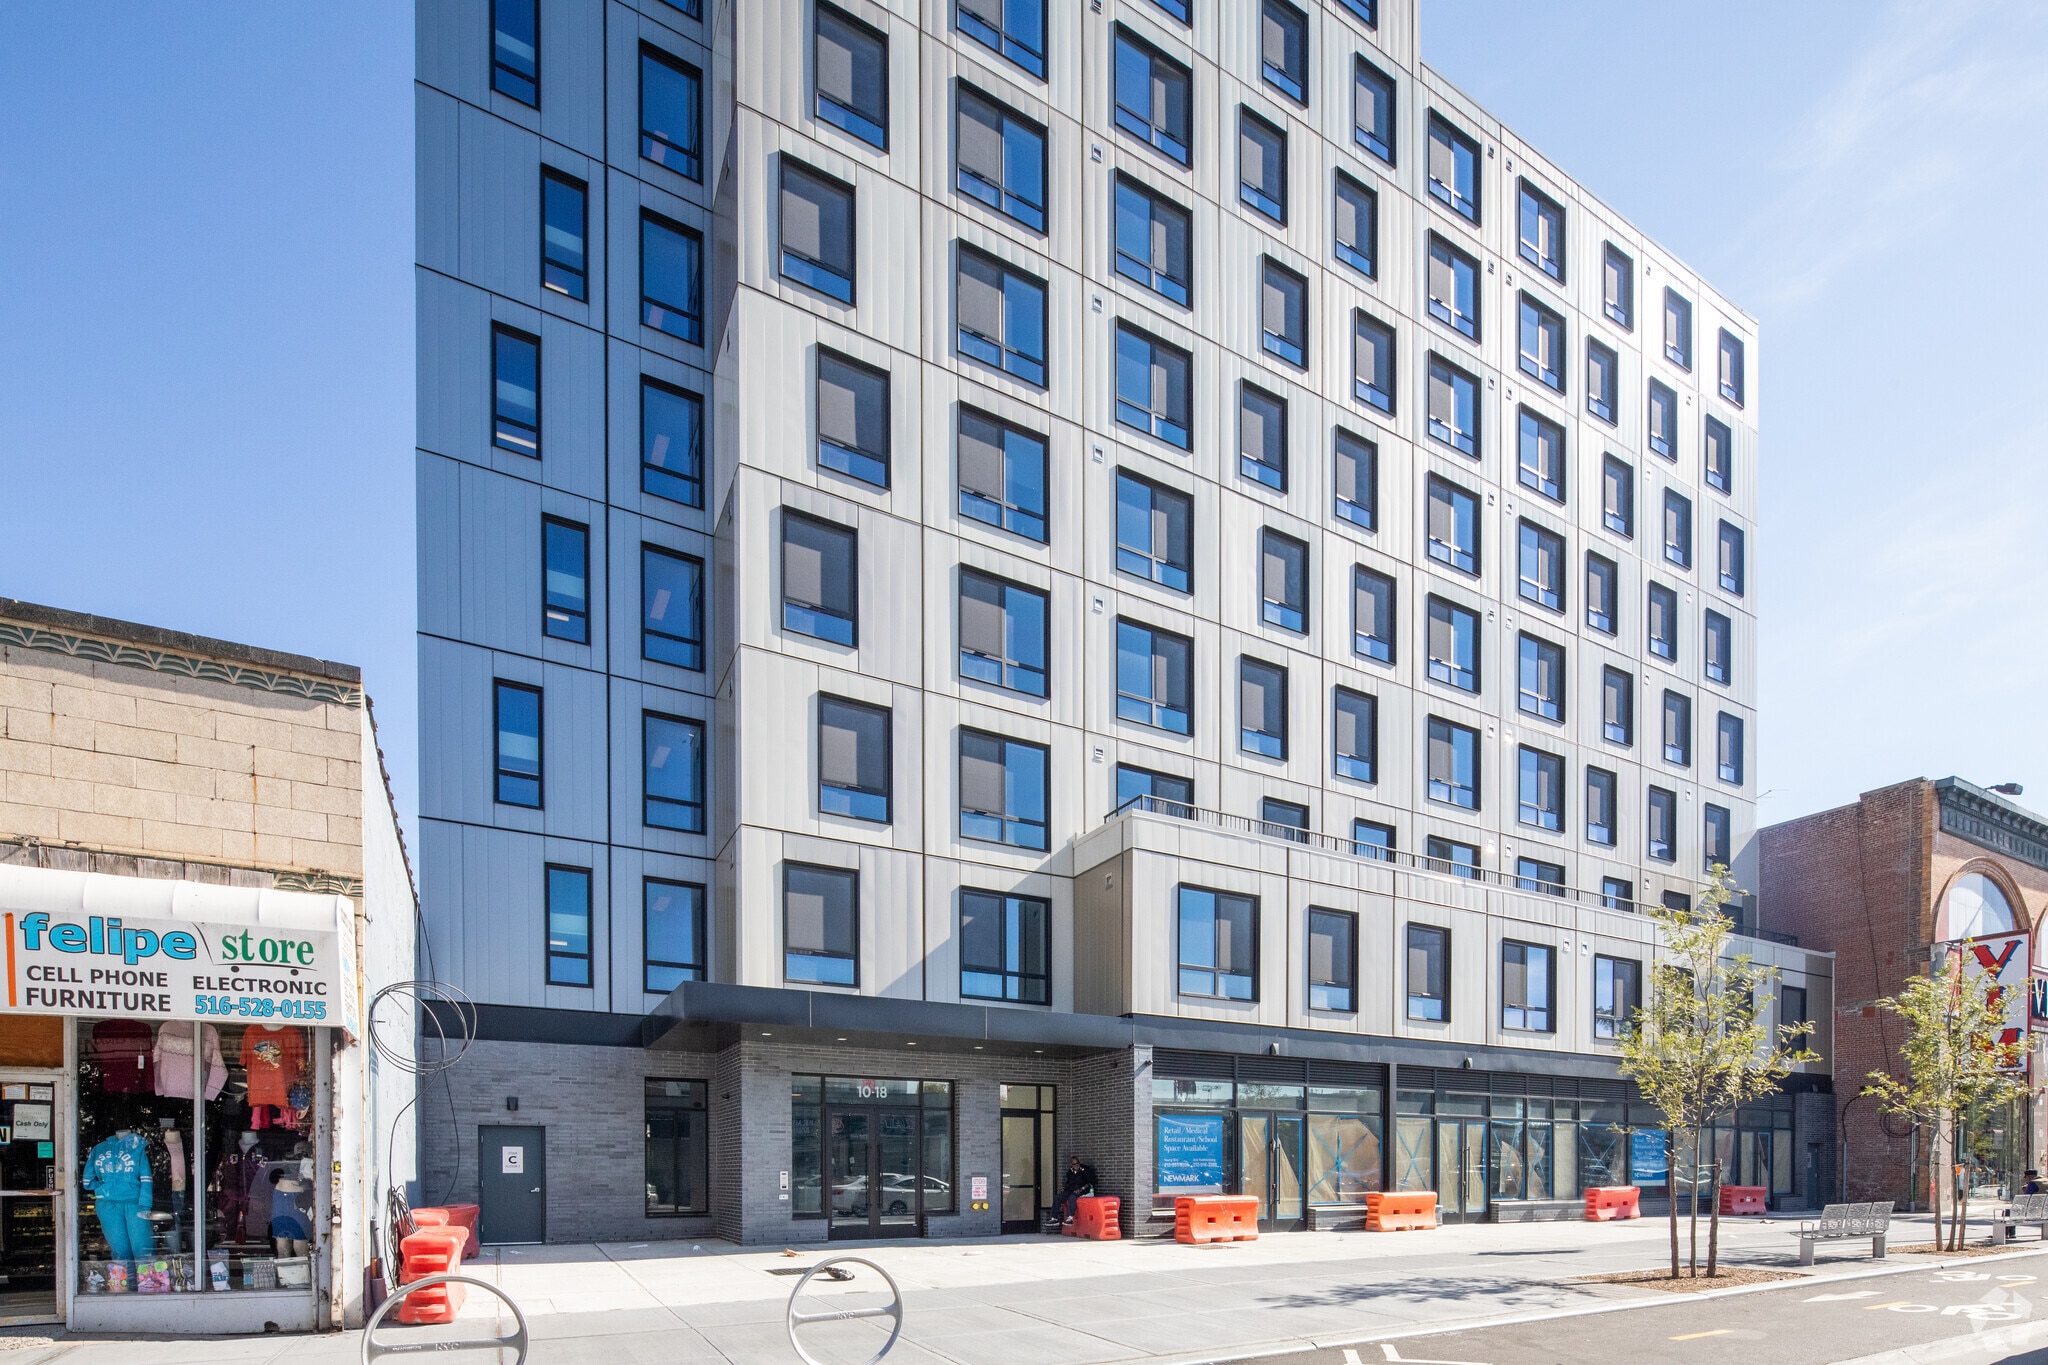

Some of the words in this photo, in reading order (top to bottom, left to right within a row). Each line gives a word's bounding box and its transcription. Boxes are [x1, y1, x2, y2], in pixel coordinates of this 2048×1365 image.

[19, 911, 197, 966] felipe
[222, 928, 315, 966] store
[26, 965, 83, 983] CELL
[90, 968, 168, 987] PHONE
[193, 975, 327, 995] ELECTRONIC
[26, 987, 171, 1012] FURNITURE
[195, 994, 327, 1020] 516-528-0155
[856, 1085, 888, 1099] 10-18
[33, 1120, 49, 1129] Only
[1164, 1144, 1181, 1153] Space
[508, 1156, 517, 1164] C
[1164, 1174, 1199, 1182] NEWMARK
